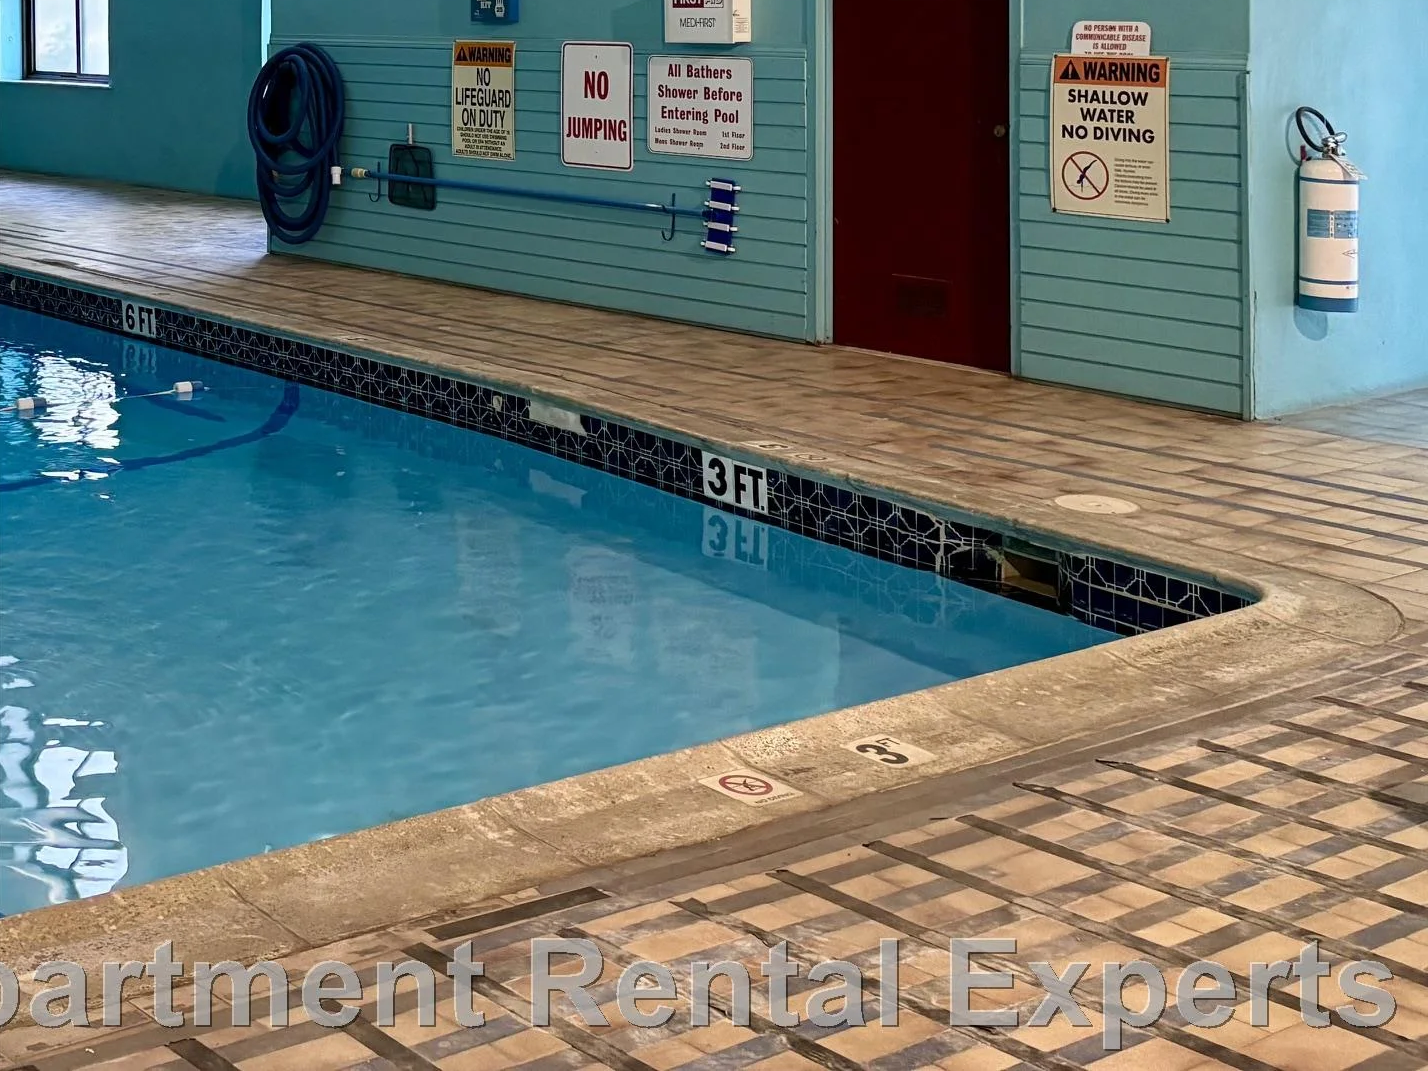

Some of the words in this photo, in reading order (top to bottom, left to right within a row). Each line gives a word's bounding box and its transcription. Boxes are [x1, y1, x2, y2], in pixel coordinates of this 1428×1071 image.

[480, 1, 492, 9] KIT
[679, 17, 716, 28] MEDI-FIRST
[1084, 24, 1092, 32] NO
[1075, 33, 1121, 41] COMMUNICABLE
[1122, 34, 1147, 42] DISEASE
[1092, 42, 1099, 50] IS
[1101, 43, 1127, 51] ALLOWED
[468, 46, 511, 63] WARNING
[476, 67, 491, 86] NO
[668, 63, 681, 78] All
[687, 64, 732, 80] Bathers
[1083, 61, 1160, 83] WARNING
[584, 70, 609, 100] NO
[658, 84, 698, 99] Shower
[704, 86, 743, 102] Before
[455, 87, 511, 108] LIFEGUARD
[1068, 88, 1149, 106] SHALLOW
[461, 108, 476, 126] ON
[479, 109, 505, 128] DUTY
[661, 105, 709, 124] Entering
[714, 109, 739, 124] Pool
[1080, 107, 1135, 124] WATER
[566, 116, 627, 142] JUMPING
[673, 127, 691, 135] Shower
[1061, 124, 1088, 139] NO
[1093, 126, 1155, 144] DIVING
[670, 138, 688, 146] Shower
[690, 140, 704, 148] Room
[125, 303, 135, 330] 6
[708, 457, 727, 496] 3
[734, 464, 765, 513] FT.
[875, 737, 901, 748] FT
[855, 743, 909, 764] 3
